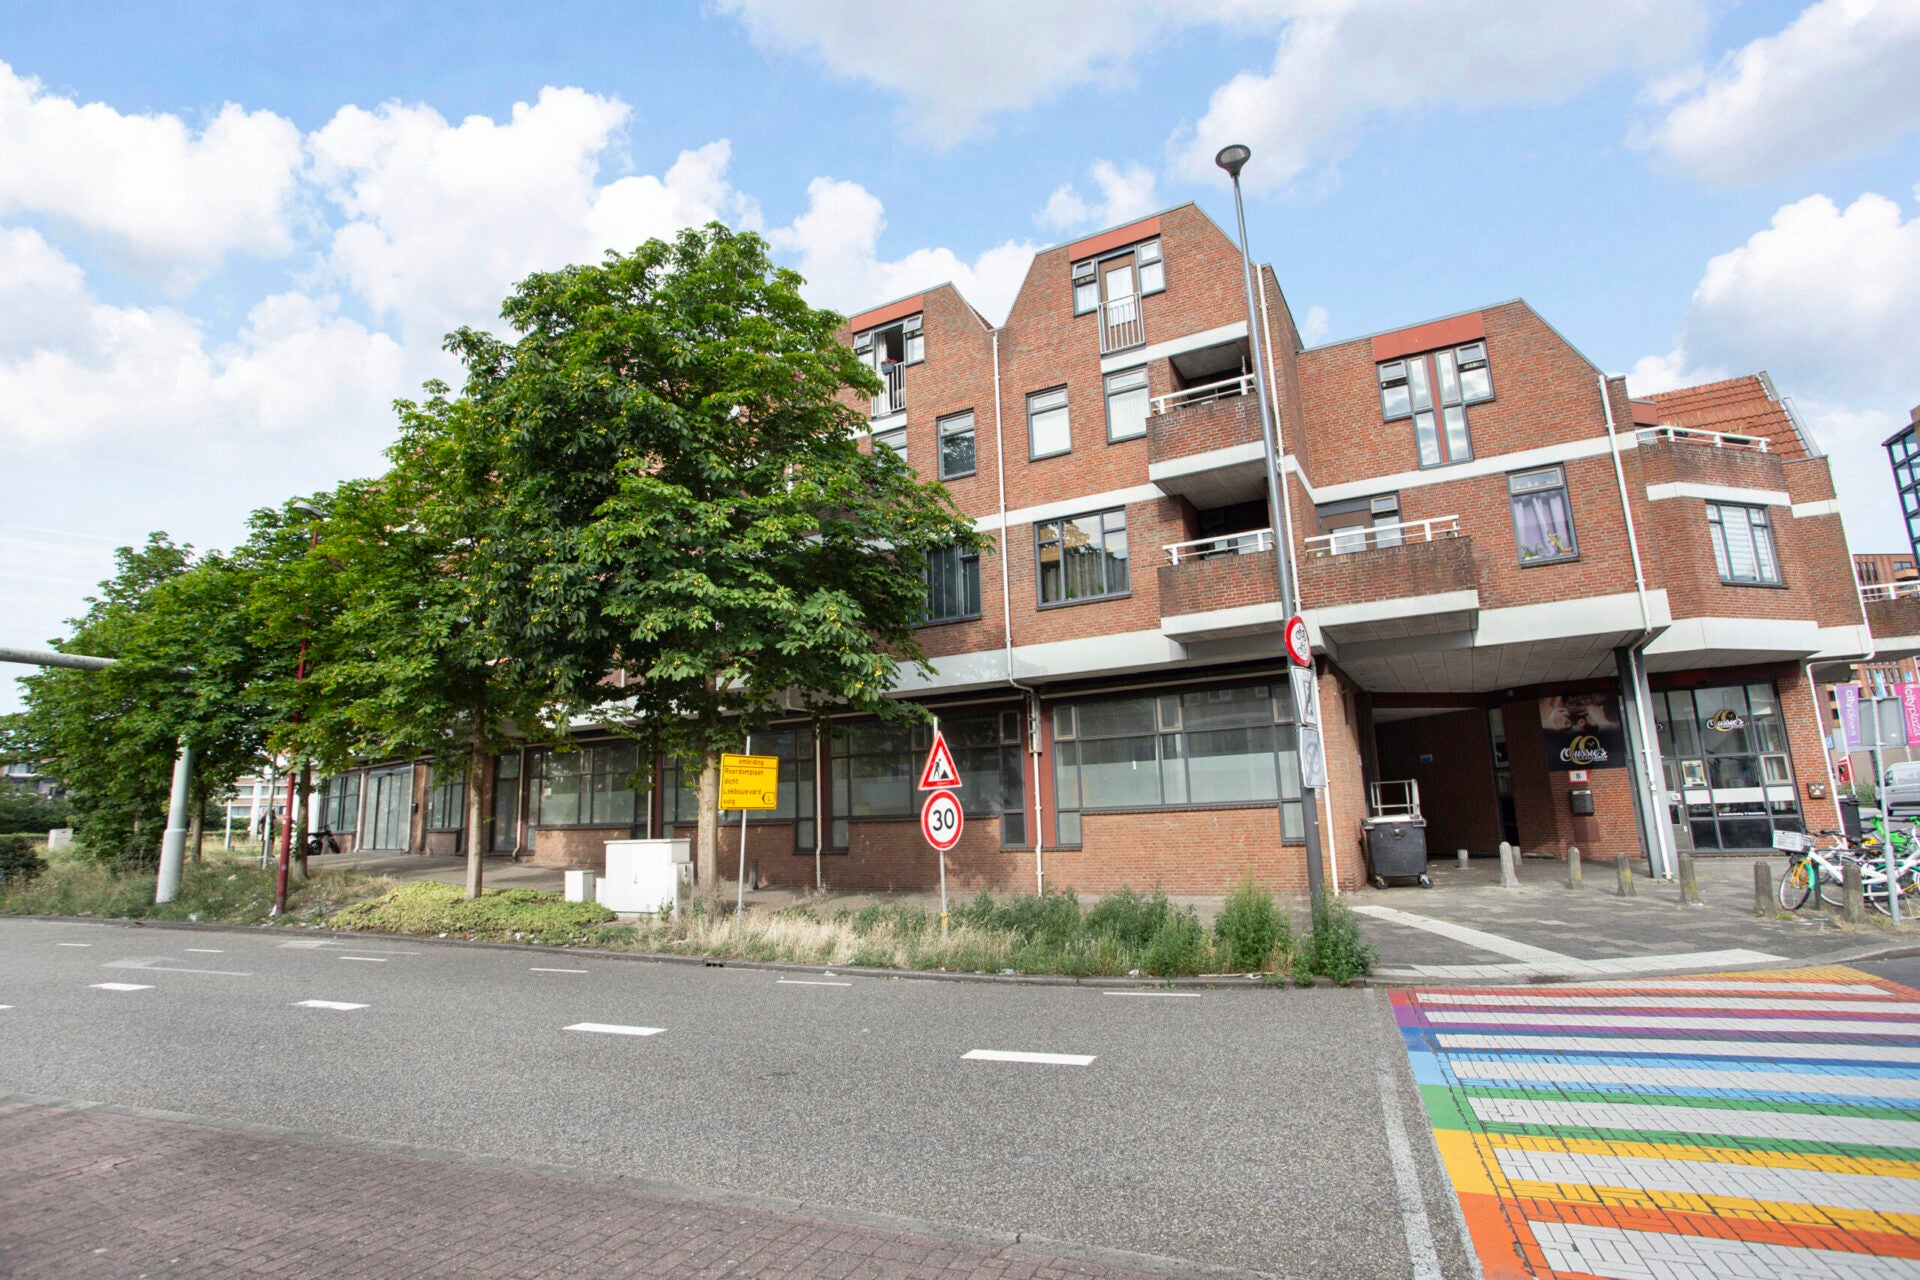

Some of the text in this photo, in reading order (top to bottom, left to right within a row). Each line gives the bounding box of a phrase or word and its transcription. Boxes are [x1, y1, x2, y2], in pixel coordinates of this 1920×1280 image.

[725, 768, 764, 776] Roerdomplaan
[723, 798, 736, 806] volg
[932, 808, 955, 832] 30
